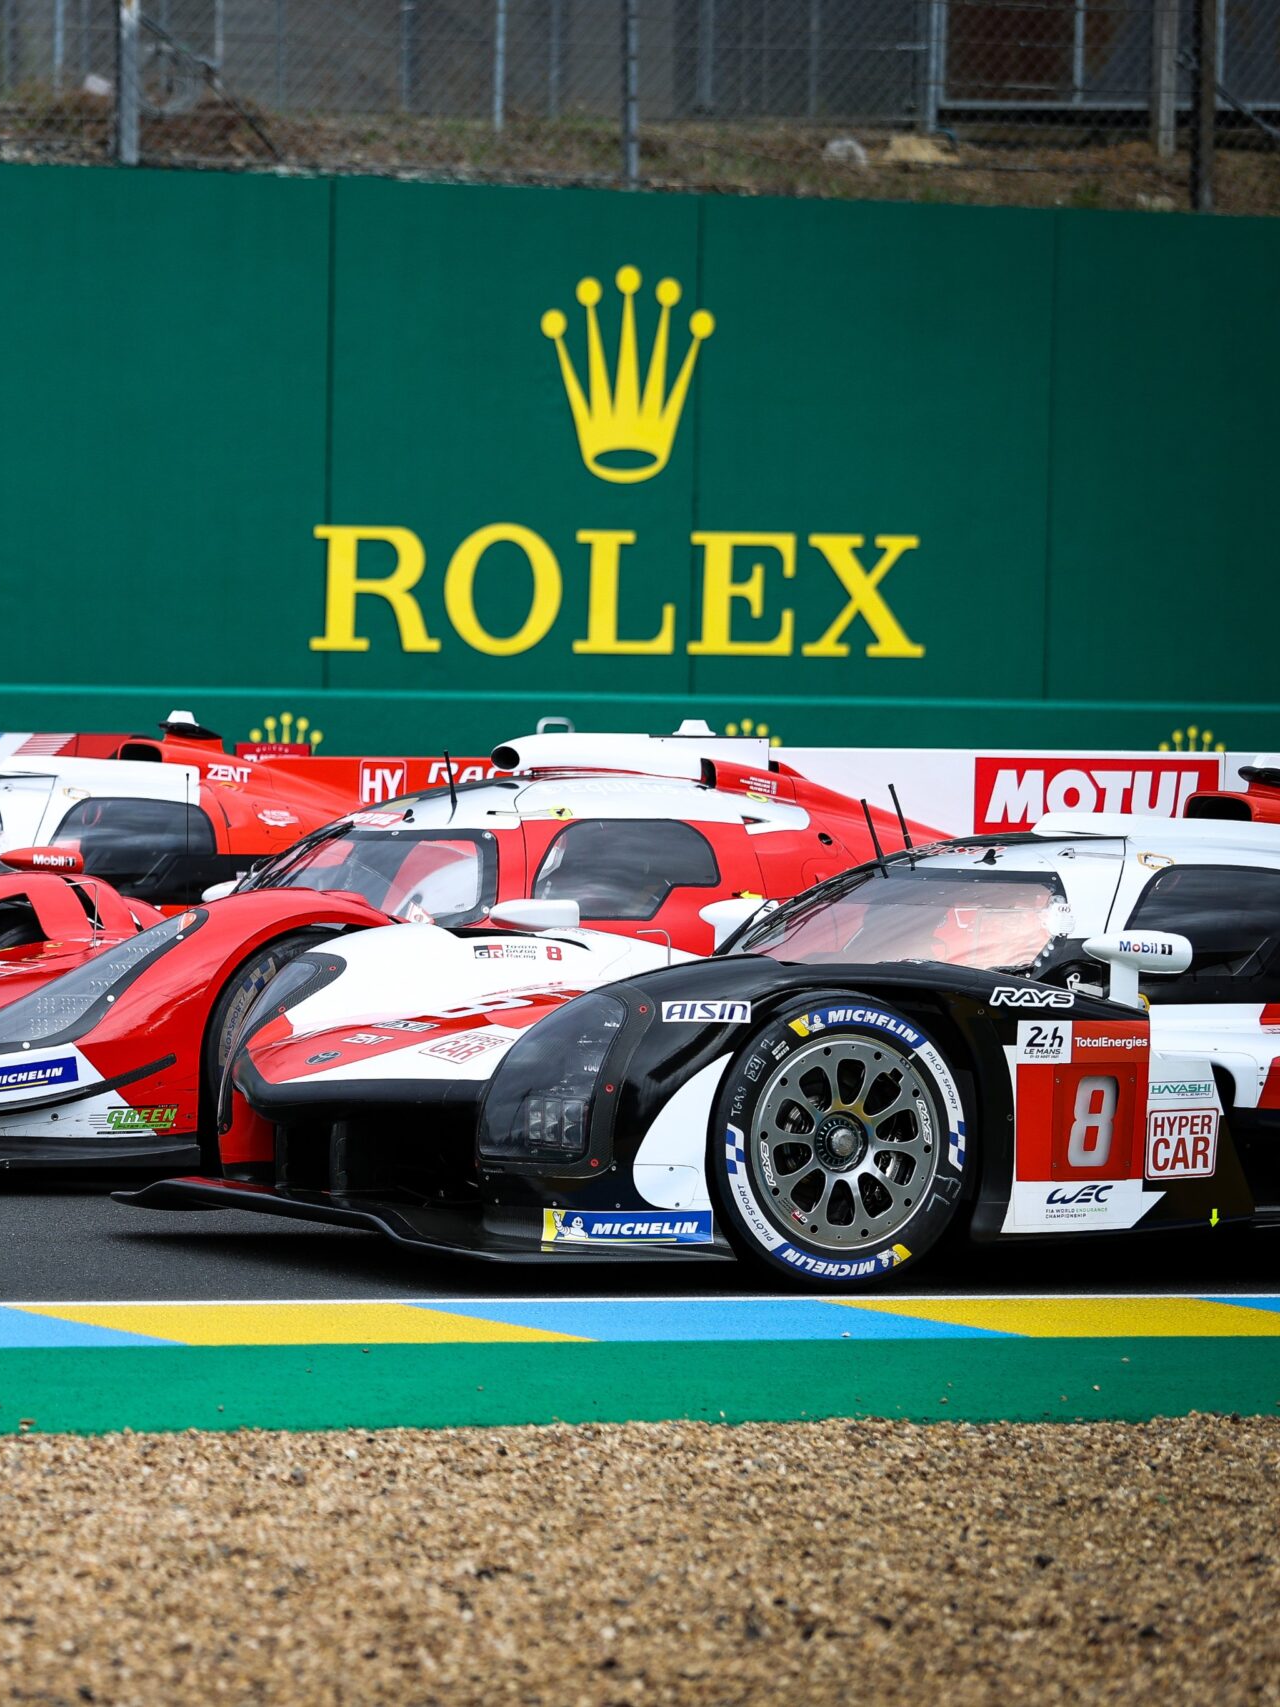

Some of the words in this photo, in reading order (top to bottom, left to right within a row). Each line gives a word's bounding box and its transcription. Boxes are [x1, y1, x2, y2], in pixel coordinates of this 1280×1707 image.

[309, 522, 925, 659] ROLEX
[207, 763, 252, 783] ZENT
[362, 768, 404, 803] HY
[32, 854, 65, 866] Mobil
[546, 946, 563, 961] 8
[1119, 940, 1158, 954] Mobil
[989, 987, 1075, 1008] RAYS
[664, 1002, 748, 1021] AISIN
[827, 1009, 919, 1044] MICHELIN
[1074, 1037, 1148, 1050] TotalEnergies
[925, 1050, 946, 1077] PILOT
[942, 1078, 959, 1112] SPORT
[1150, 1083, 1211, 1094] HAYASHI
[106, 1108, 178, 1126] GREEN
[916, 1099, 933, 1145] RAYS
[1067, 1075, 1120, 1167] 8
[1153, 1114, 1213, 1137] HYPER
[760, 1140, 777, 1187] RAYS
[1151, 1137, 1211, 1172] CAR
[737, 1183, 756, 1216] SPORT
[1046, 1184, 1114, 1205] WEC
[591, 1220, 699, 1237] MICHELIN
[752, 1218, 775, 1242] PILOT
[781, 1248, 875, 1277] MICHELIN
